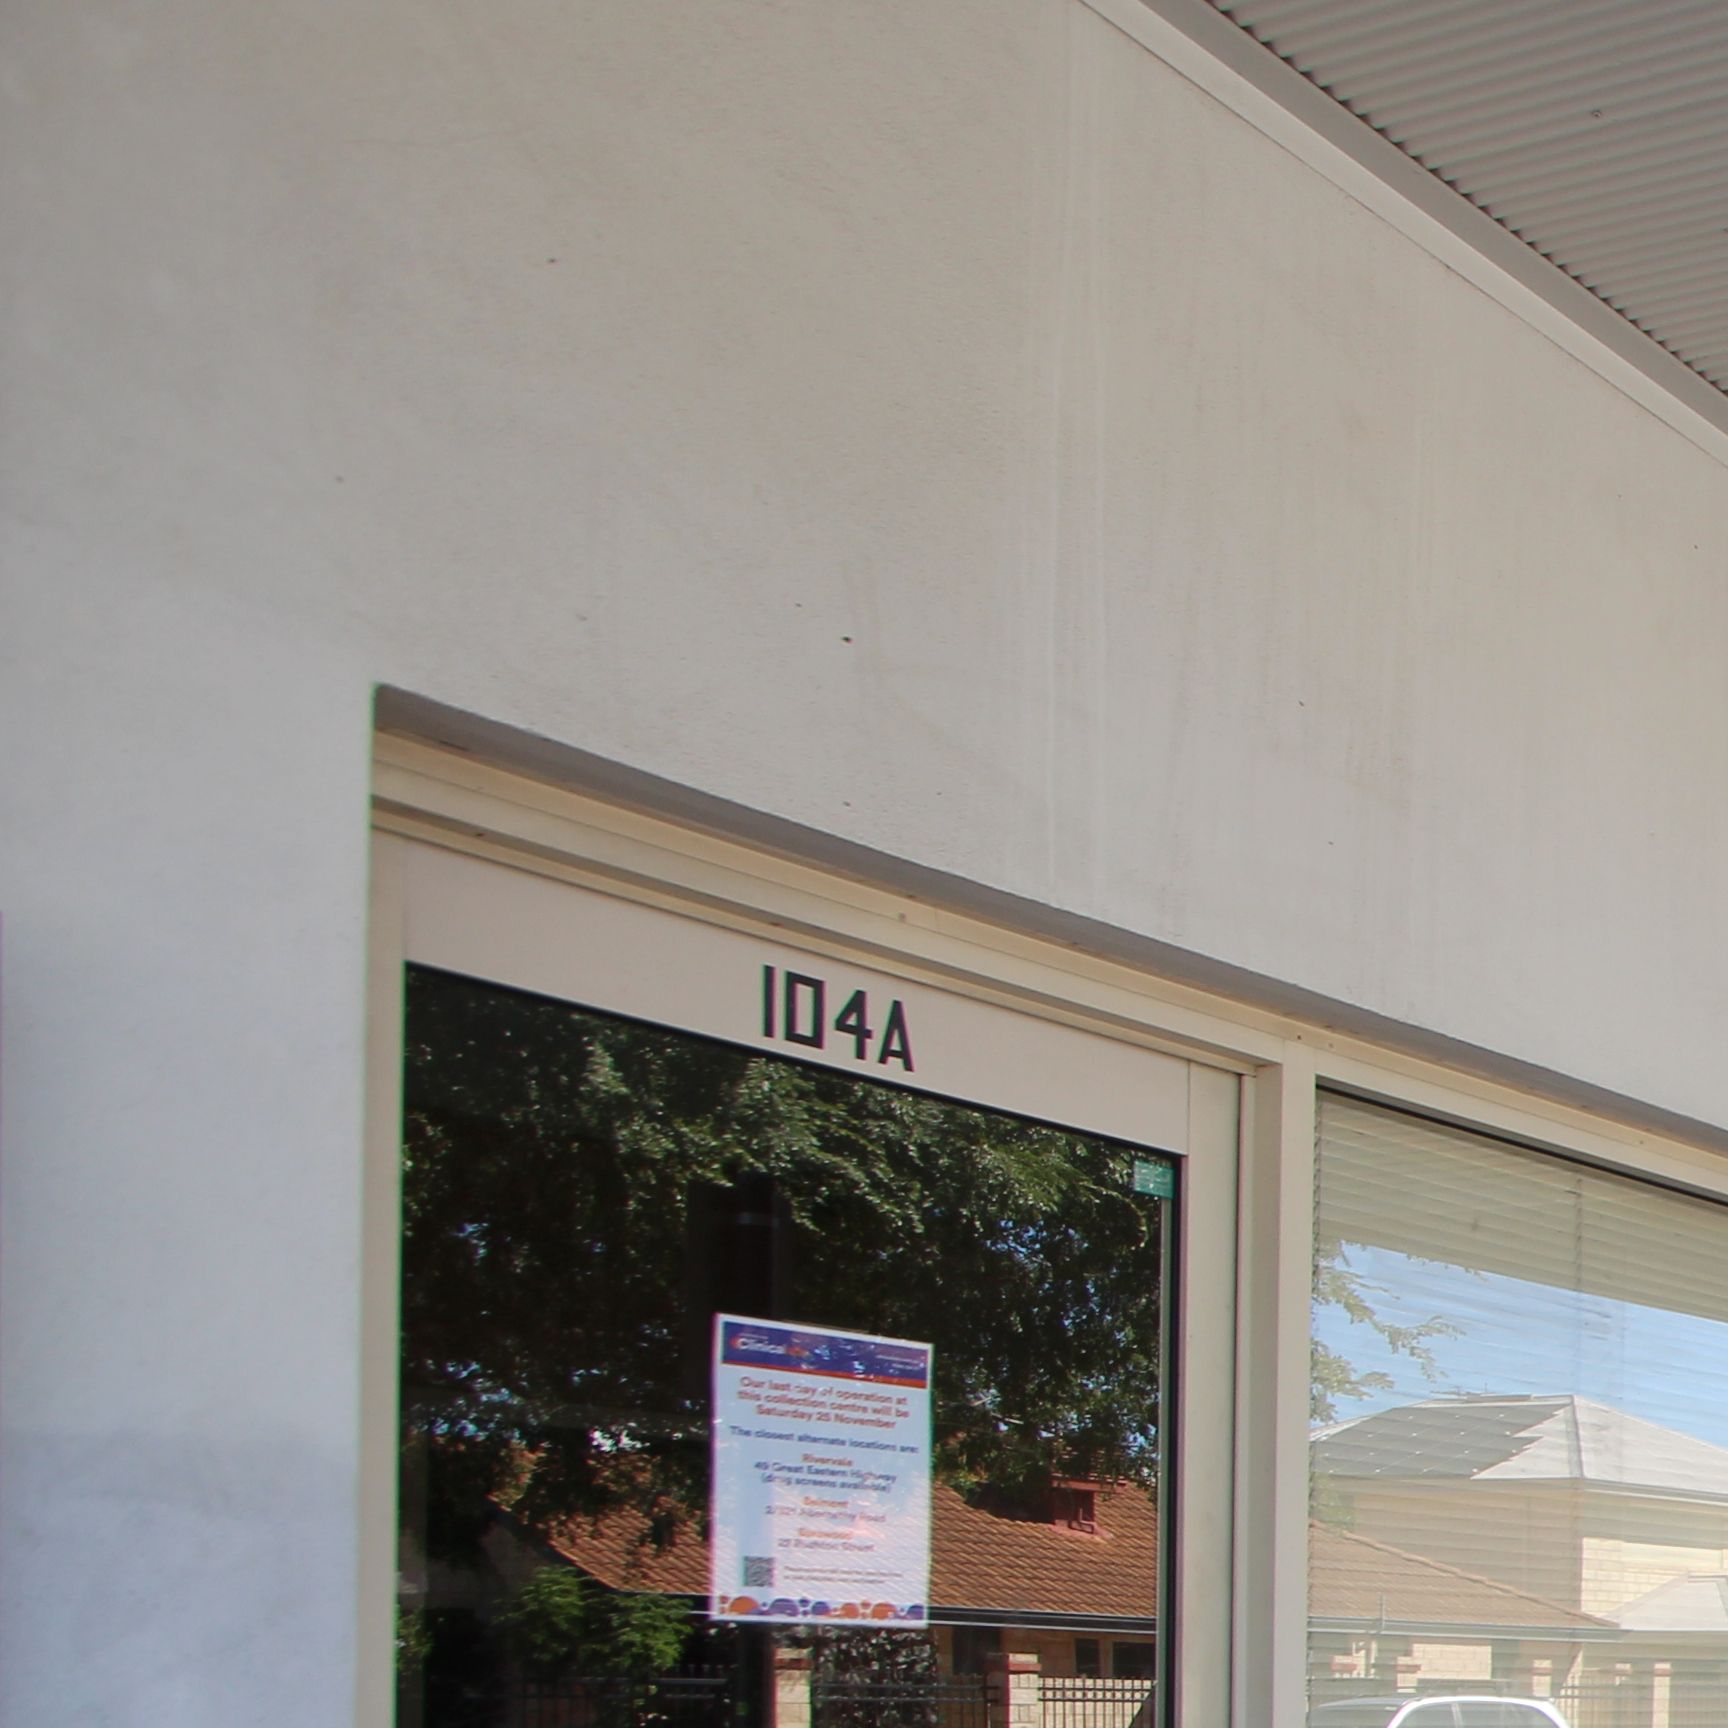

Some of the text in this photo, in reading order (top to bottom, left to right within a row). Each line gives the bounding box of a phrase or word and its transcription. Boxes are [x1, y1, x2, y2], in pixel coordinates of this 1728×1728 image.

[763, 964, 915, 1072] 104A
[740, 1376, 765, 1388] Our
[769, 1379, 790, 1392] last
[756, 1404, 813, 1421] Saturday
[834, 1413, 896, 1428] November
[730, 1426, 751, 1437] The
[754, 1429, 794, 1441] closest
[850, 1438, 896, 1451] locations
